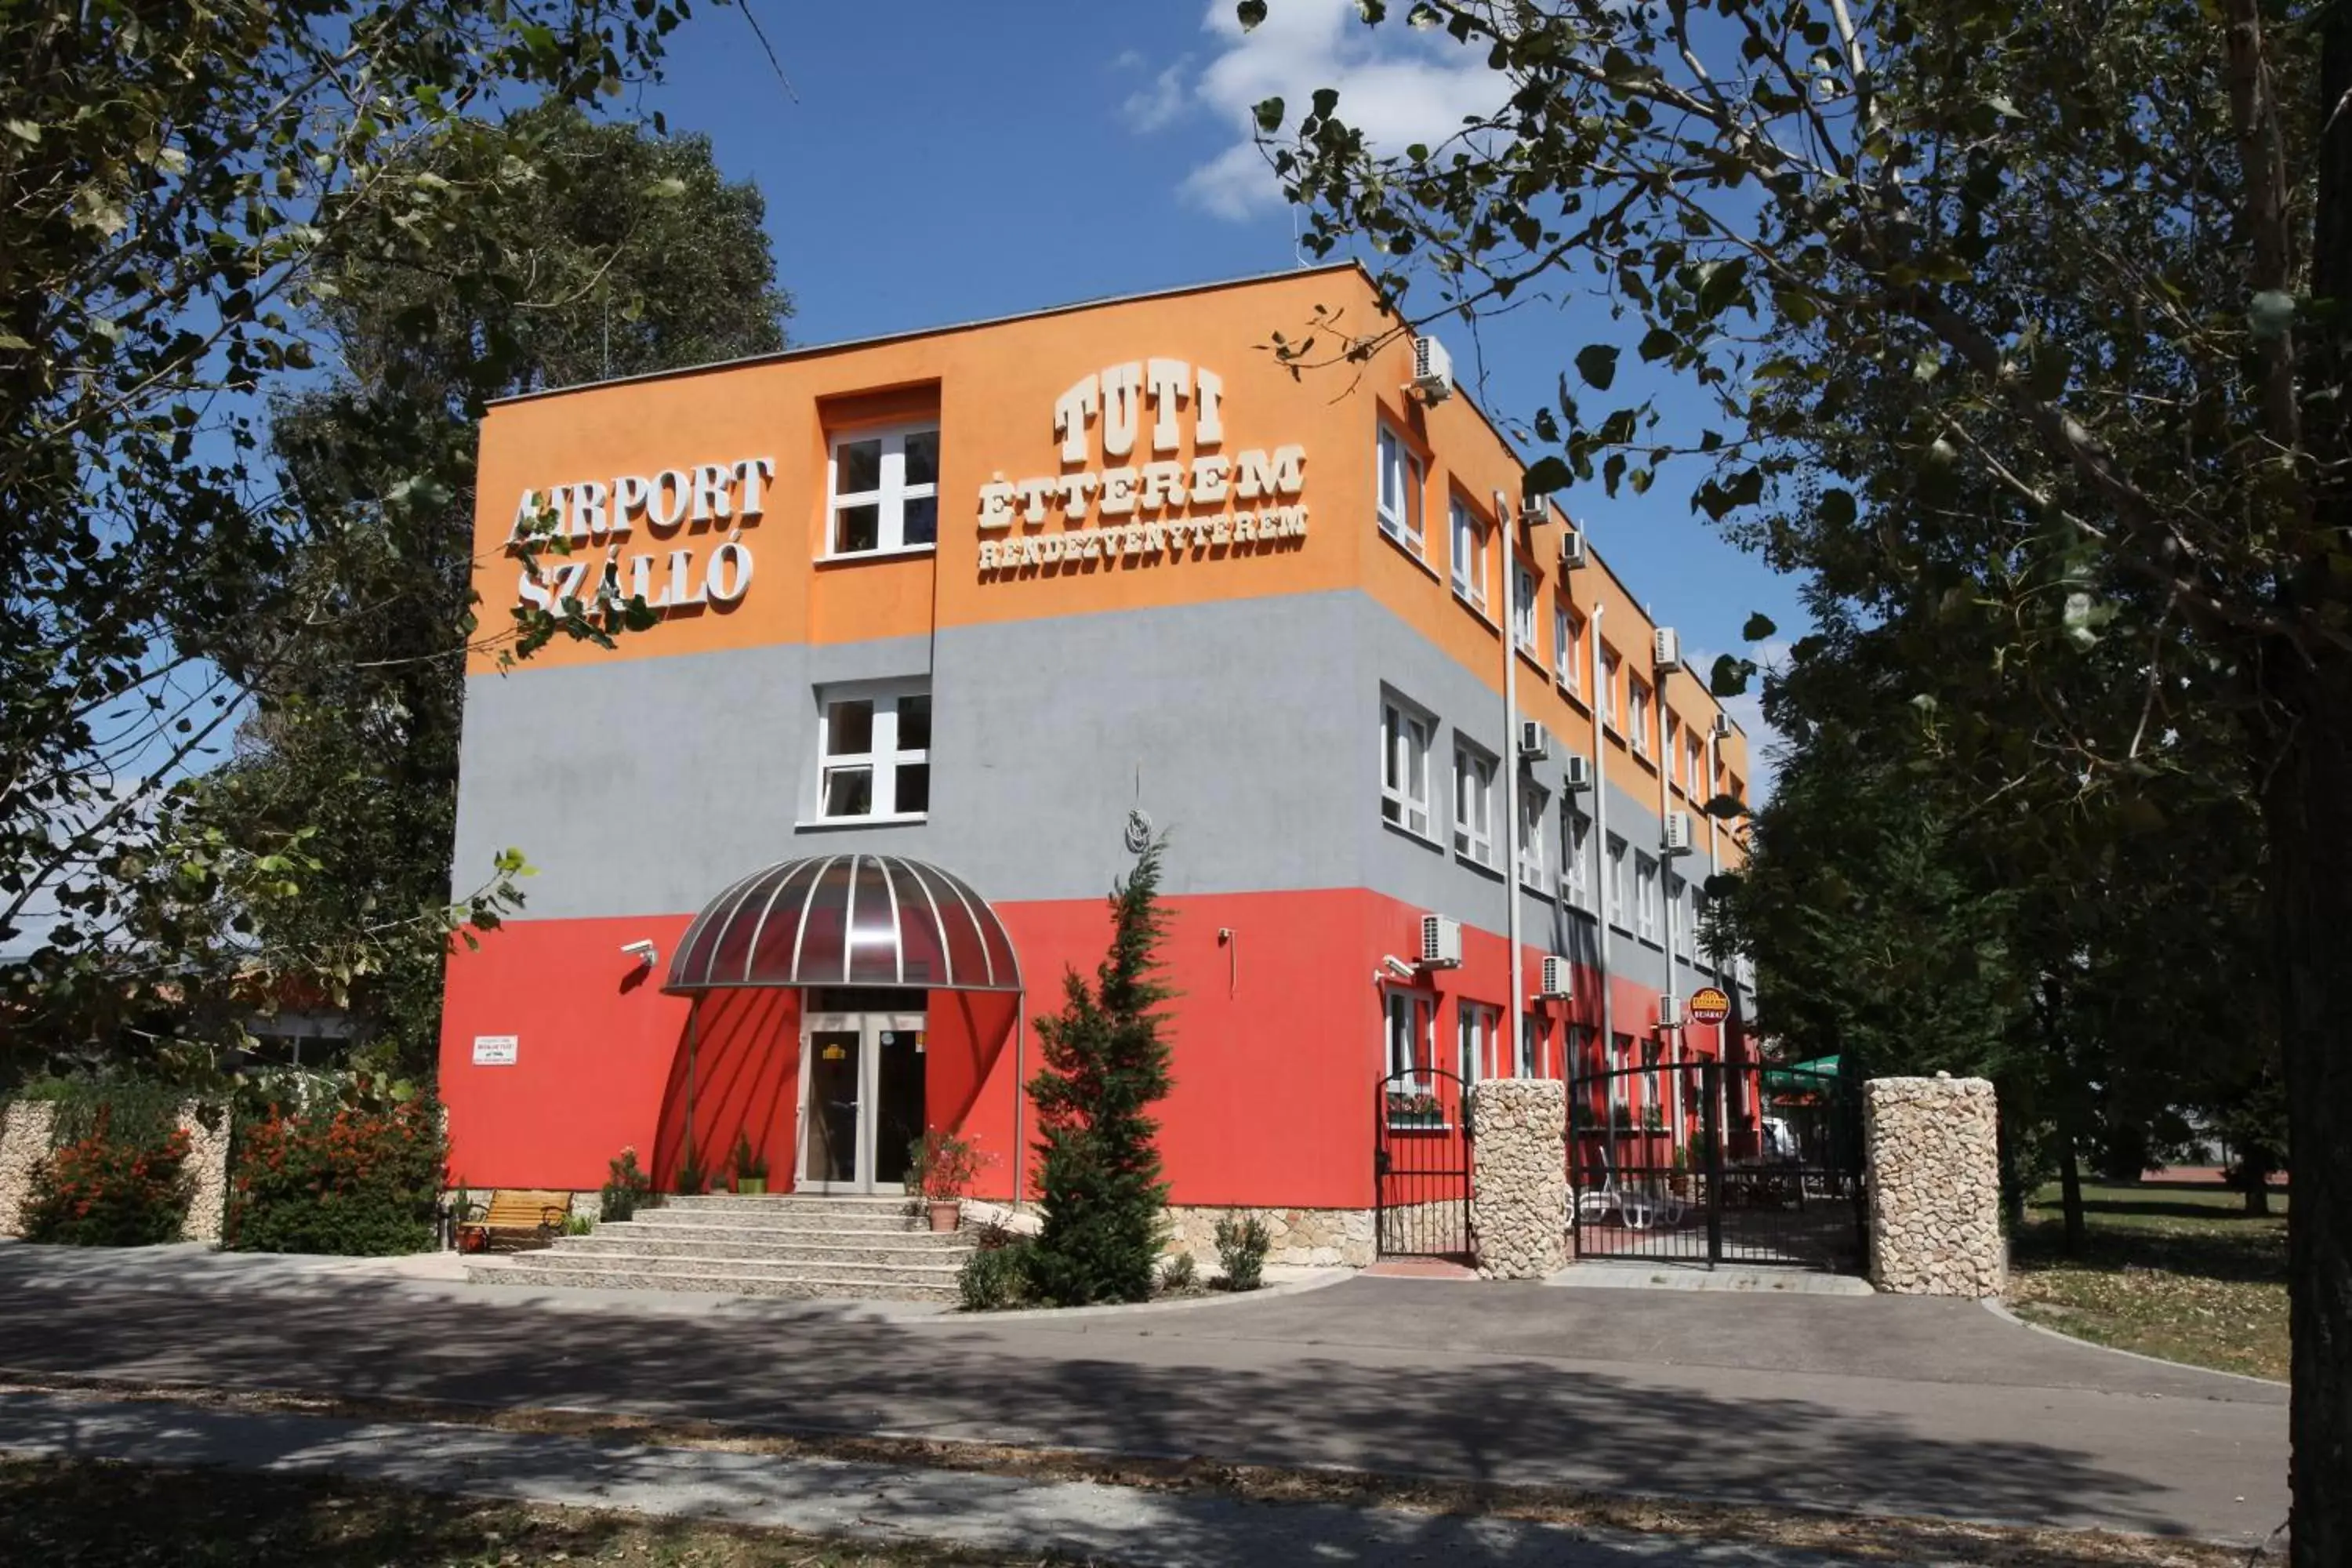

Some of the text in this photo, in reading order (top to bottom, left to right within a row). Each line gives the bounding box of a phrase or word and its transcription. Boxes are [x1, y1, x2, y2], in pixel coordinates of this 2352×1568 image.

[1054, 358, 1223, 463] TUTI
[503, 457, 775, 544] AIRPORT
[978, 445, 1307, 529] ÉTTEREM
[978, 504, 1308, 570] RENDEZVÉNYTEREM
